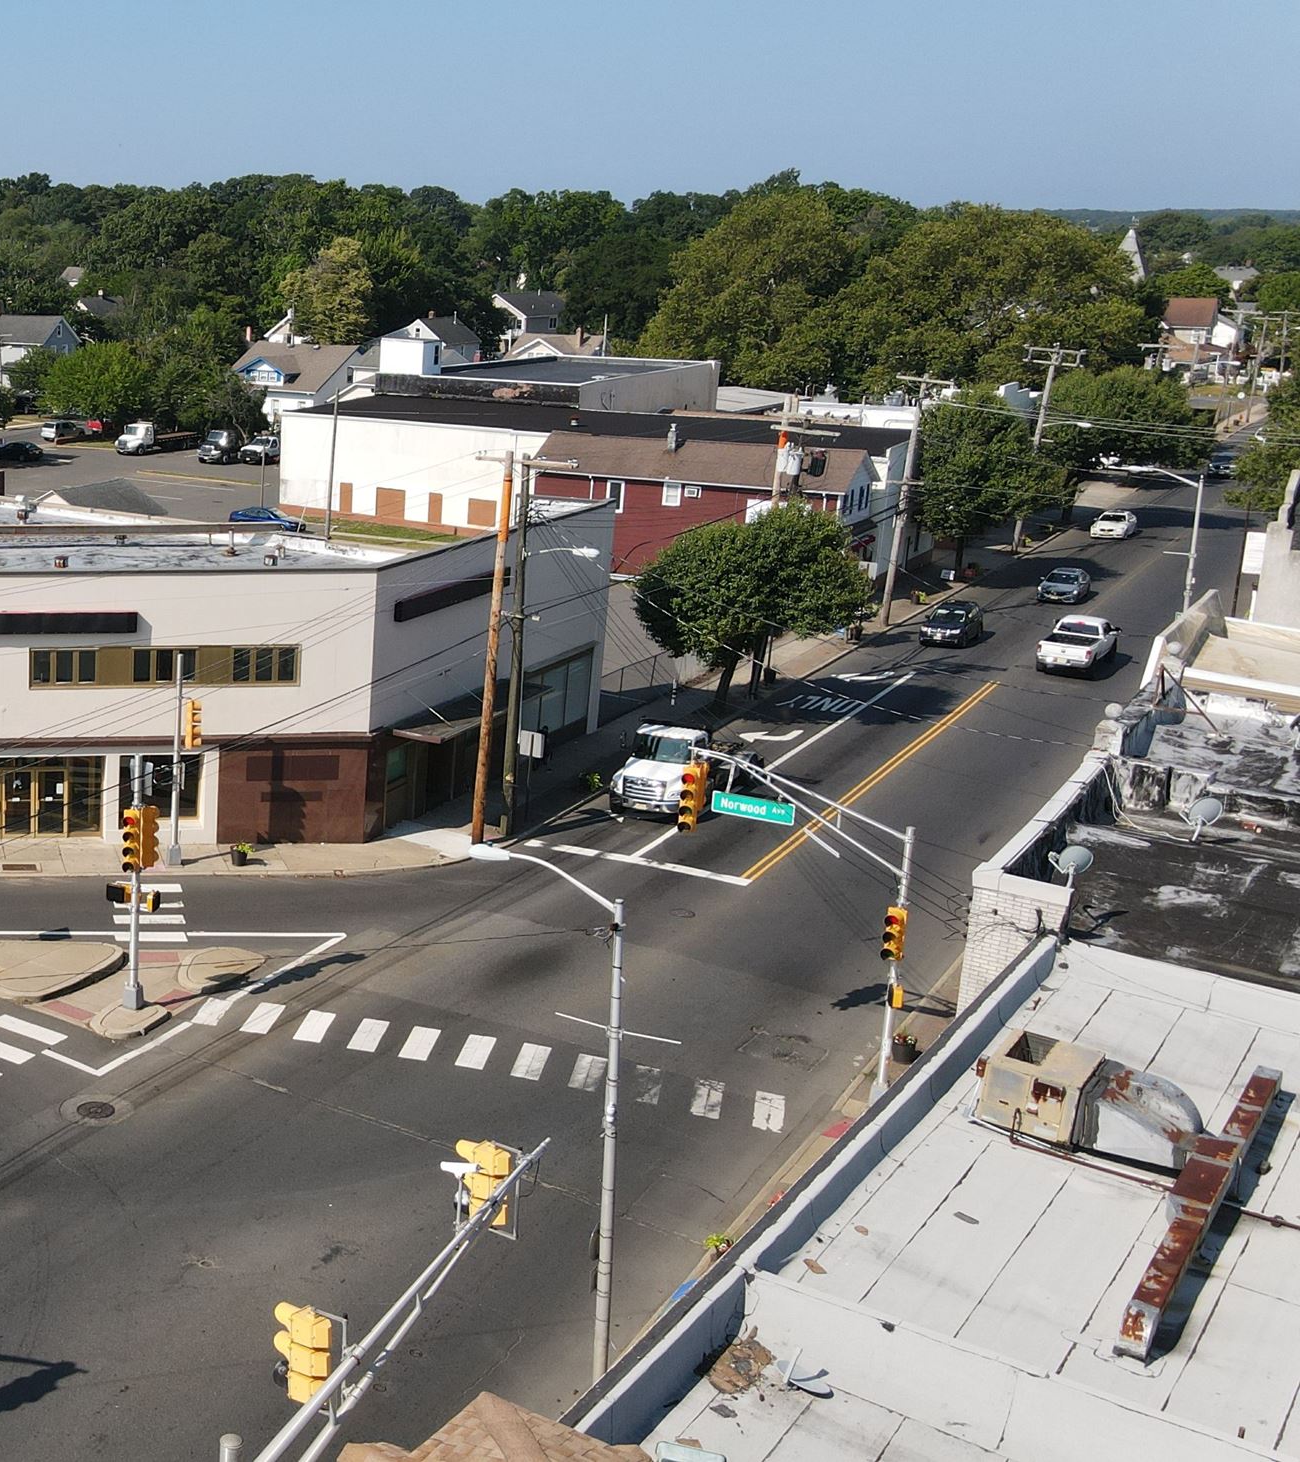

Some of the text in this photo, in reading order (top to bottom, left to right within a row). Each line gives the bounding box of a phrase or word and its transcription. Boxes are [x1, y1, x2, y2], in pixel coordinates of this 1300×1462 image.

[775, 694, 859, 714] ONLY
[720, 797, 786, 816] Norwood Ave
